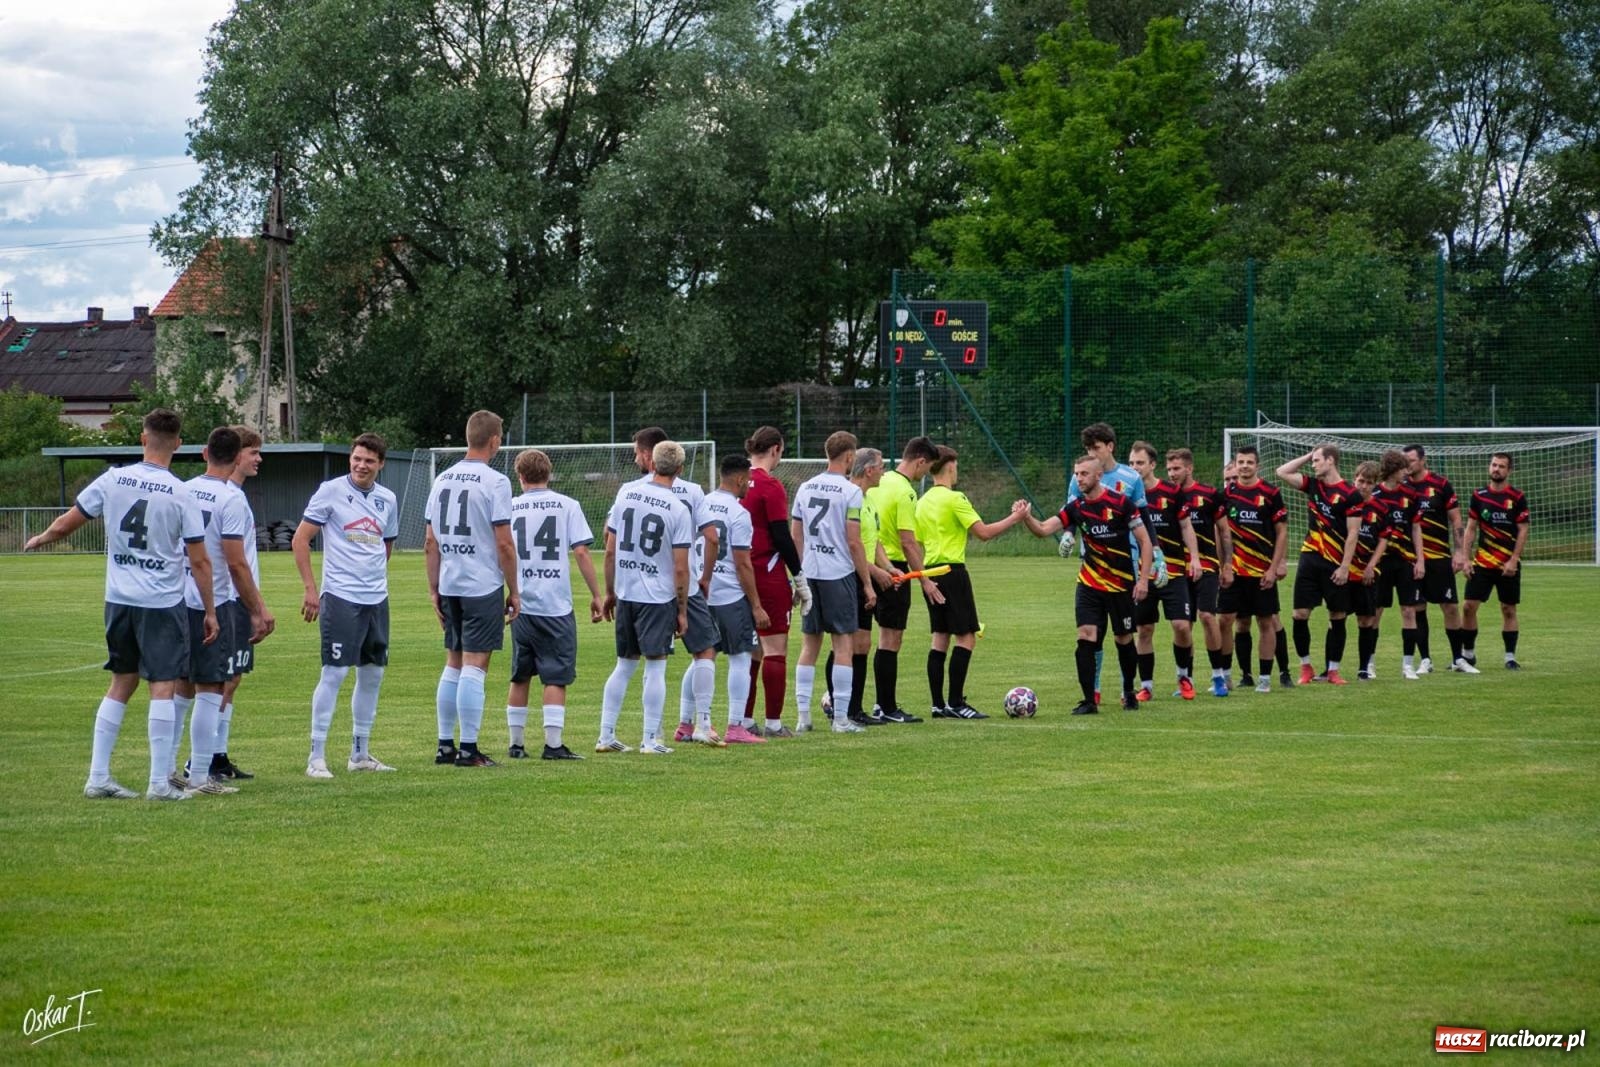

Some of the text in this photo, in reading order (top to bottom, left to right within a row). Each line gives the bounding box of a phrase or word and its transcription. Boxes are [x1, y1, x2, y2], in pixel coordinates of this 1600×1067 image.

[934, 309, 964, 326] 0 min.
[951, 329, 978, 341] GOŚCIE
[964, 347, 977, 363] 0
[117, 476, 173, 496] 1908 NĘDZA
[532, 501, 563, 511] NĘDZA
[626, 492, 672, 511] 1908 NĘDZA
[438, 488, 471, 536] 11
[807, 496, 830, 536] 7
[1149, 513, 1163, 522] UK
[1239, 510, 1258, 519] CUK
[1492, 512, 1508, 520] CUK
[120, 498, 149, 550] 4
[619, 507, 666, 557] 18
[1091, 524, 1109, 534] CUK
[512, 515, 560, 561] 14
[619, 559, 659, 574] EKO-TOX
[236, 650, 250, 667] 10
[331, 642, 342, 660] 5
